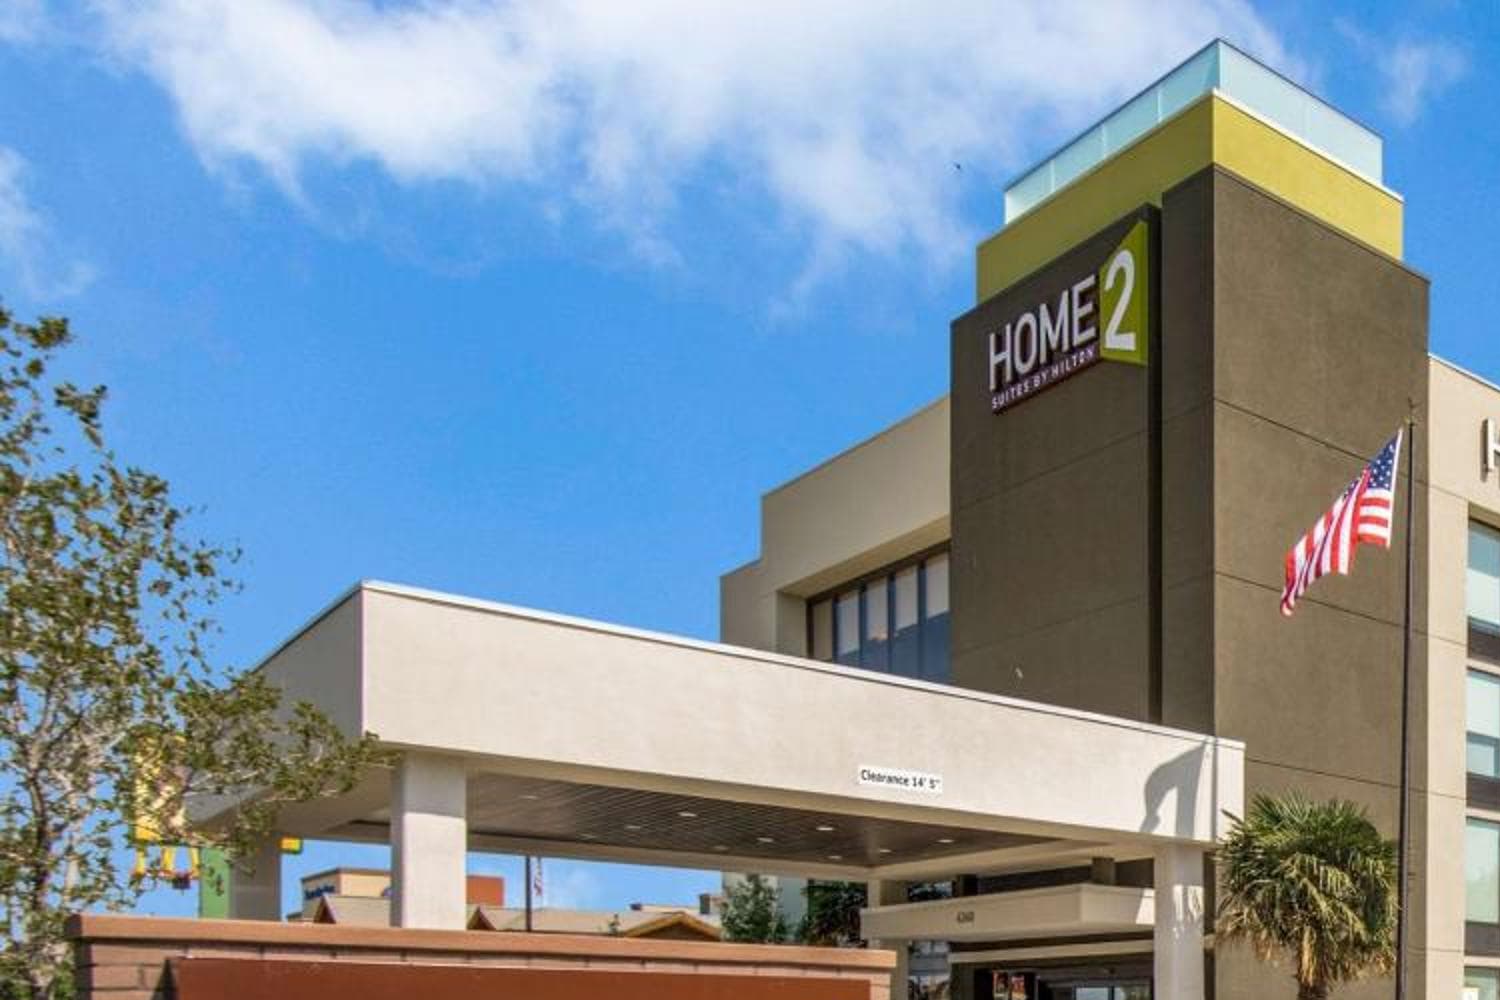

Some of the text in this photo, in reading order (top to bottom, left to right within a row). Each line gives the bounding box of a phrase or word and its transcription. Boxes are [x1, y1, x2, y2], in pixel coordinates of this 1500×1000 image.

[991, 382, 1029, 409] SUITES
[1033, 372, 1048, 388] BY
[861, 769, 909, 787] Clearance
